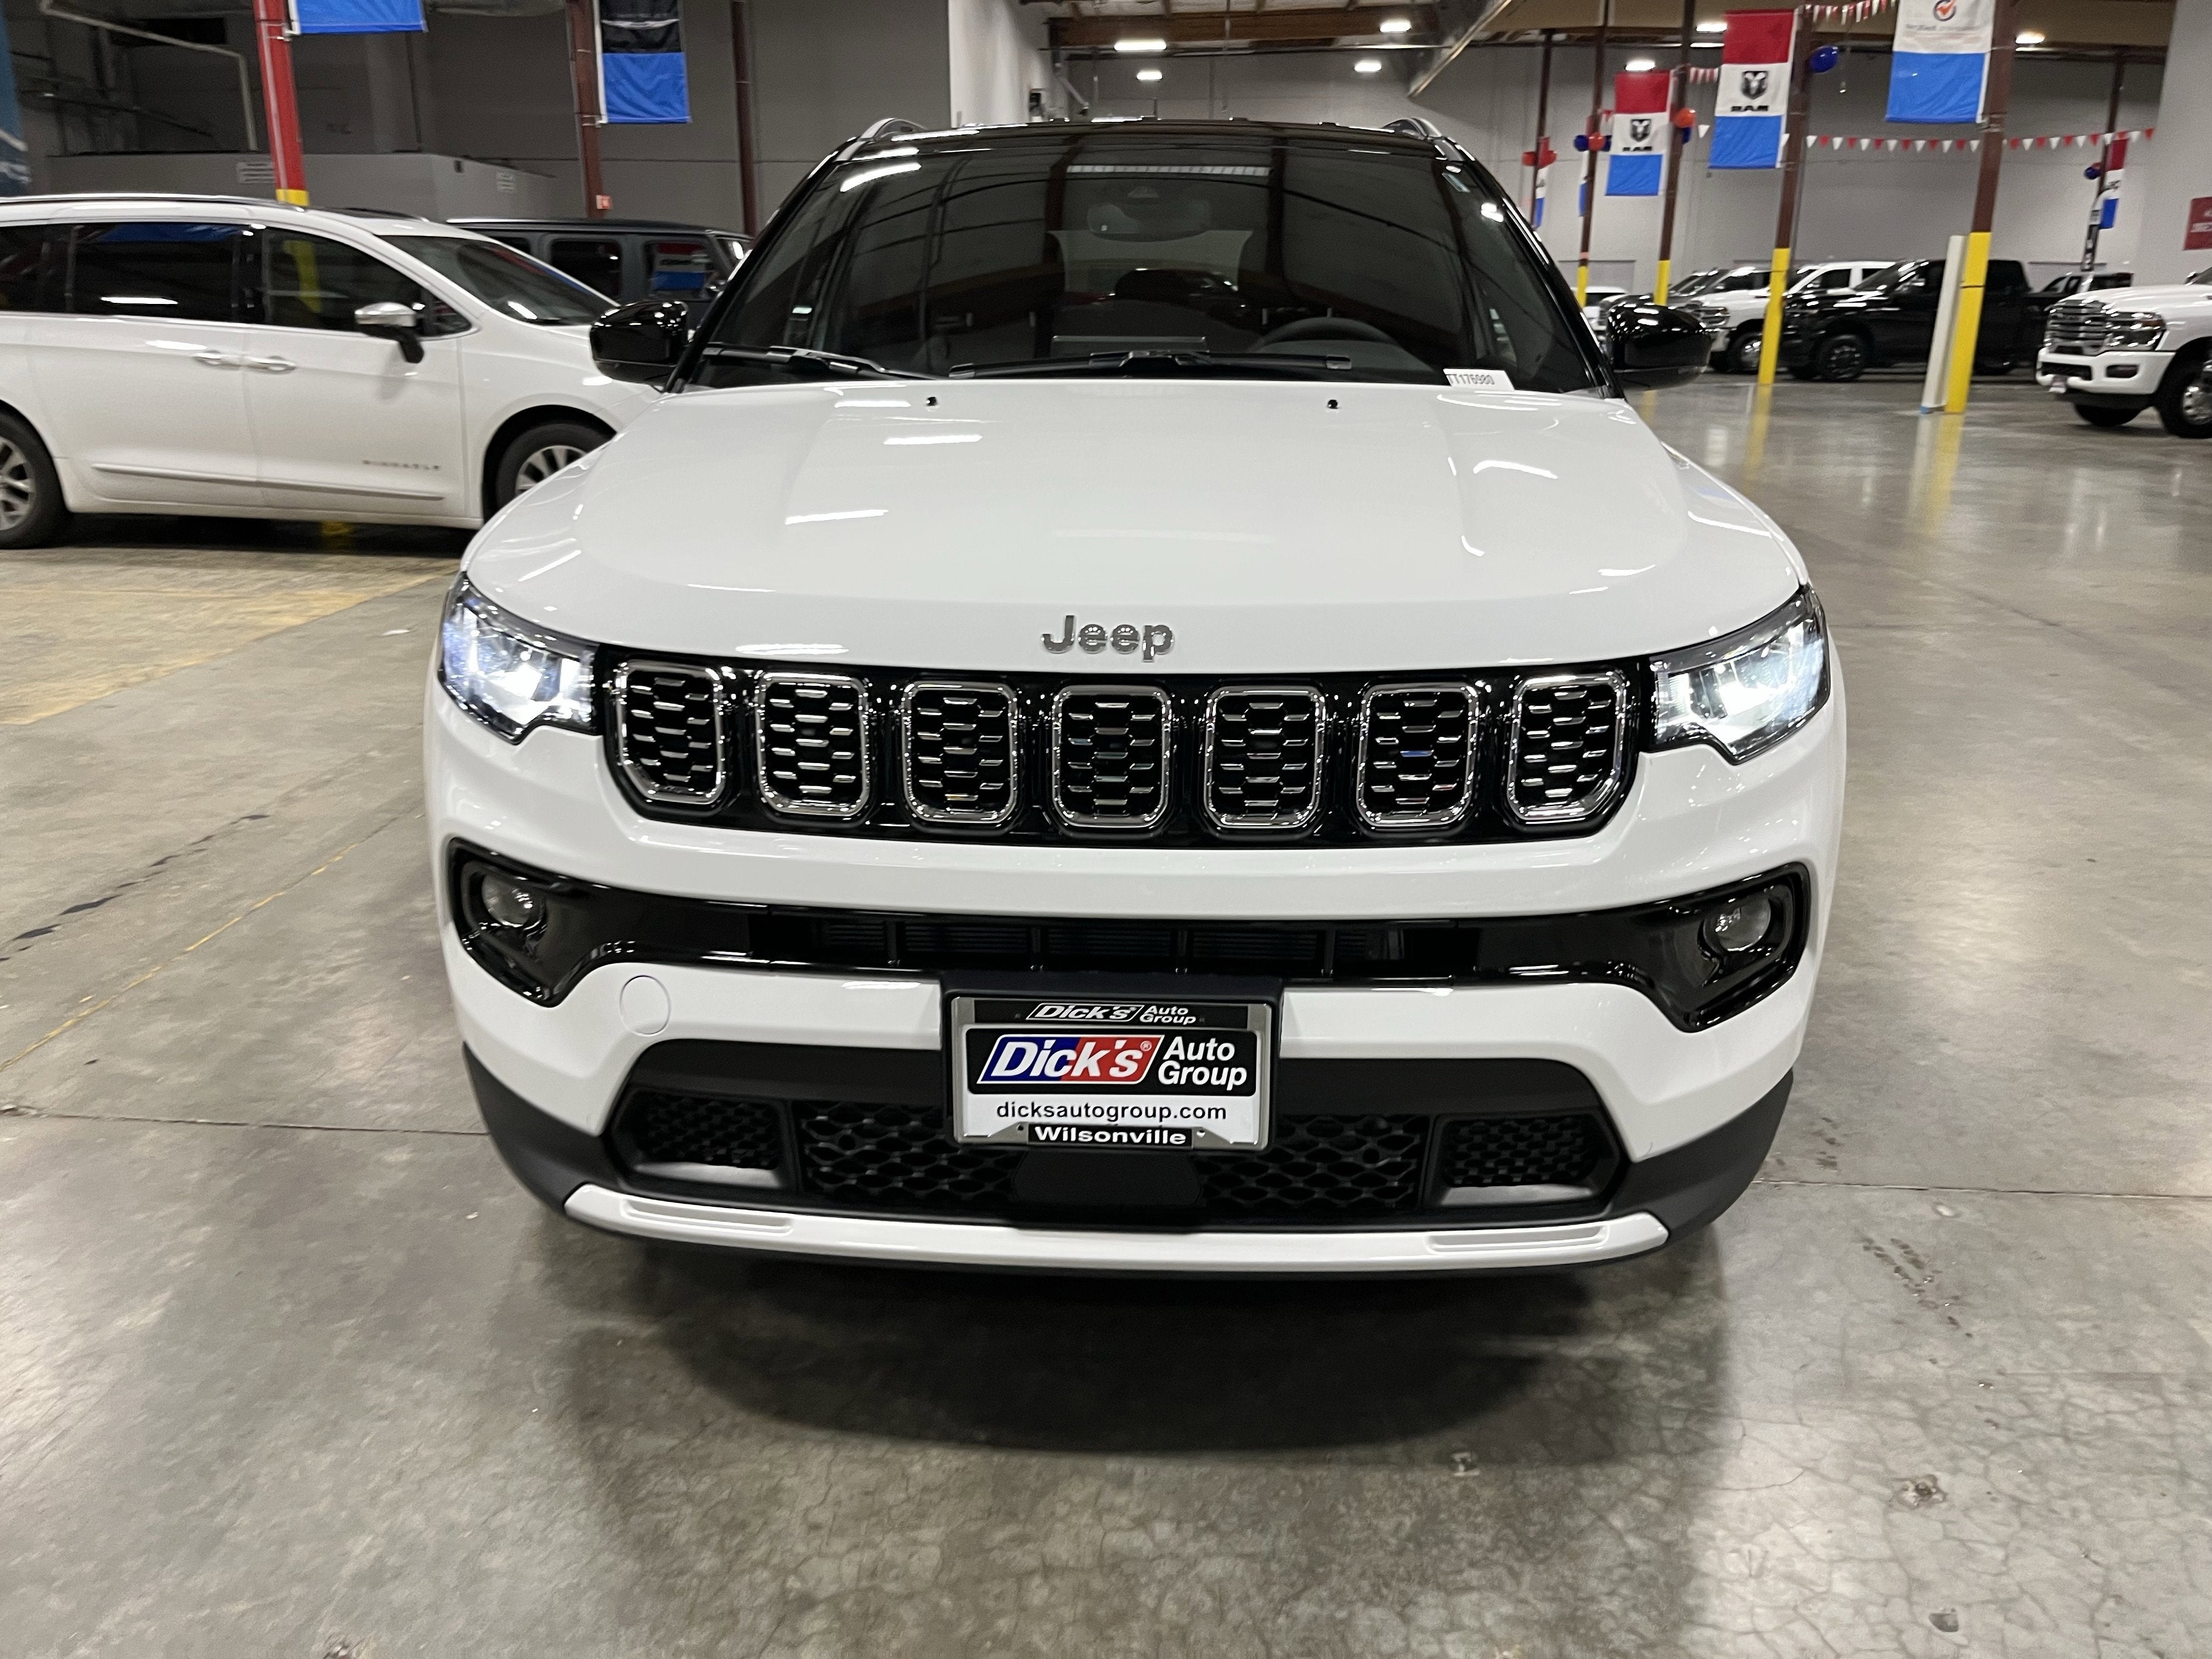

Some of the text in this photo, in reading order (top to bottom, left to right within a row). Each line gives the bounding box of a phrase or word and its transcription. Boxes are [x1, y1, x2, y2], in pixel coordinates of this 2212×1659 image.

[1040, 614, 1175, 662] Jeep
[1034, 1004, 1132, 1020] Dick's
[1139, 1013, 1197, 1025] Group
[1146, 1005, 1189, 1016] Auto
[1163, 1036, 1236, 1062] Auto
[1158, 1059, 1248, 1091] Group
[996, 1101, 1227, 1122] dicksautogroup.com
[1034, 1126, 1187, 1145] Wilsonville
